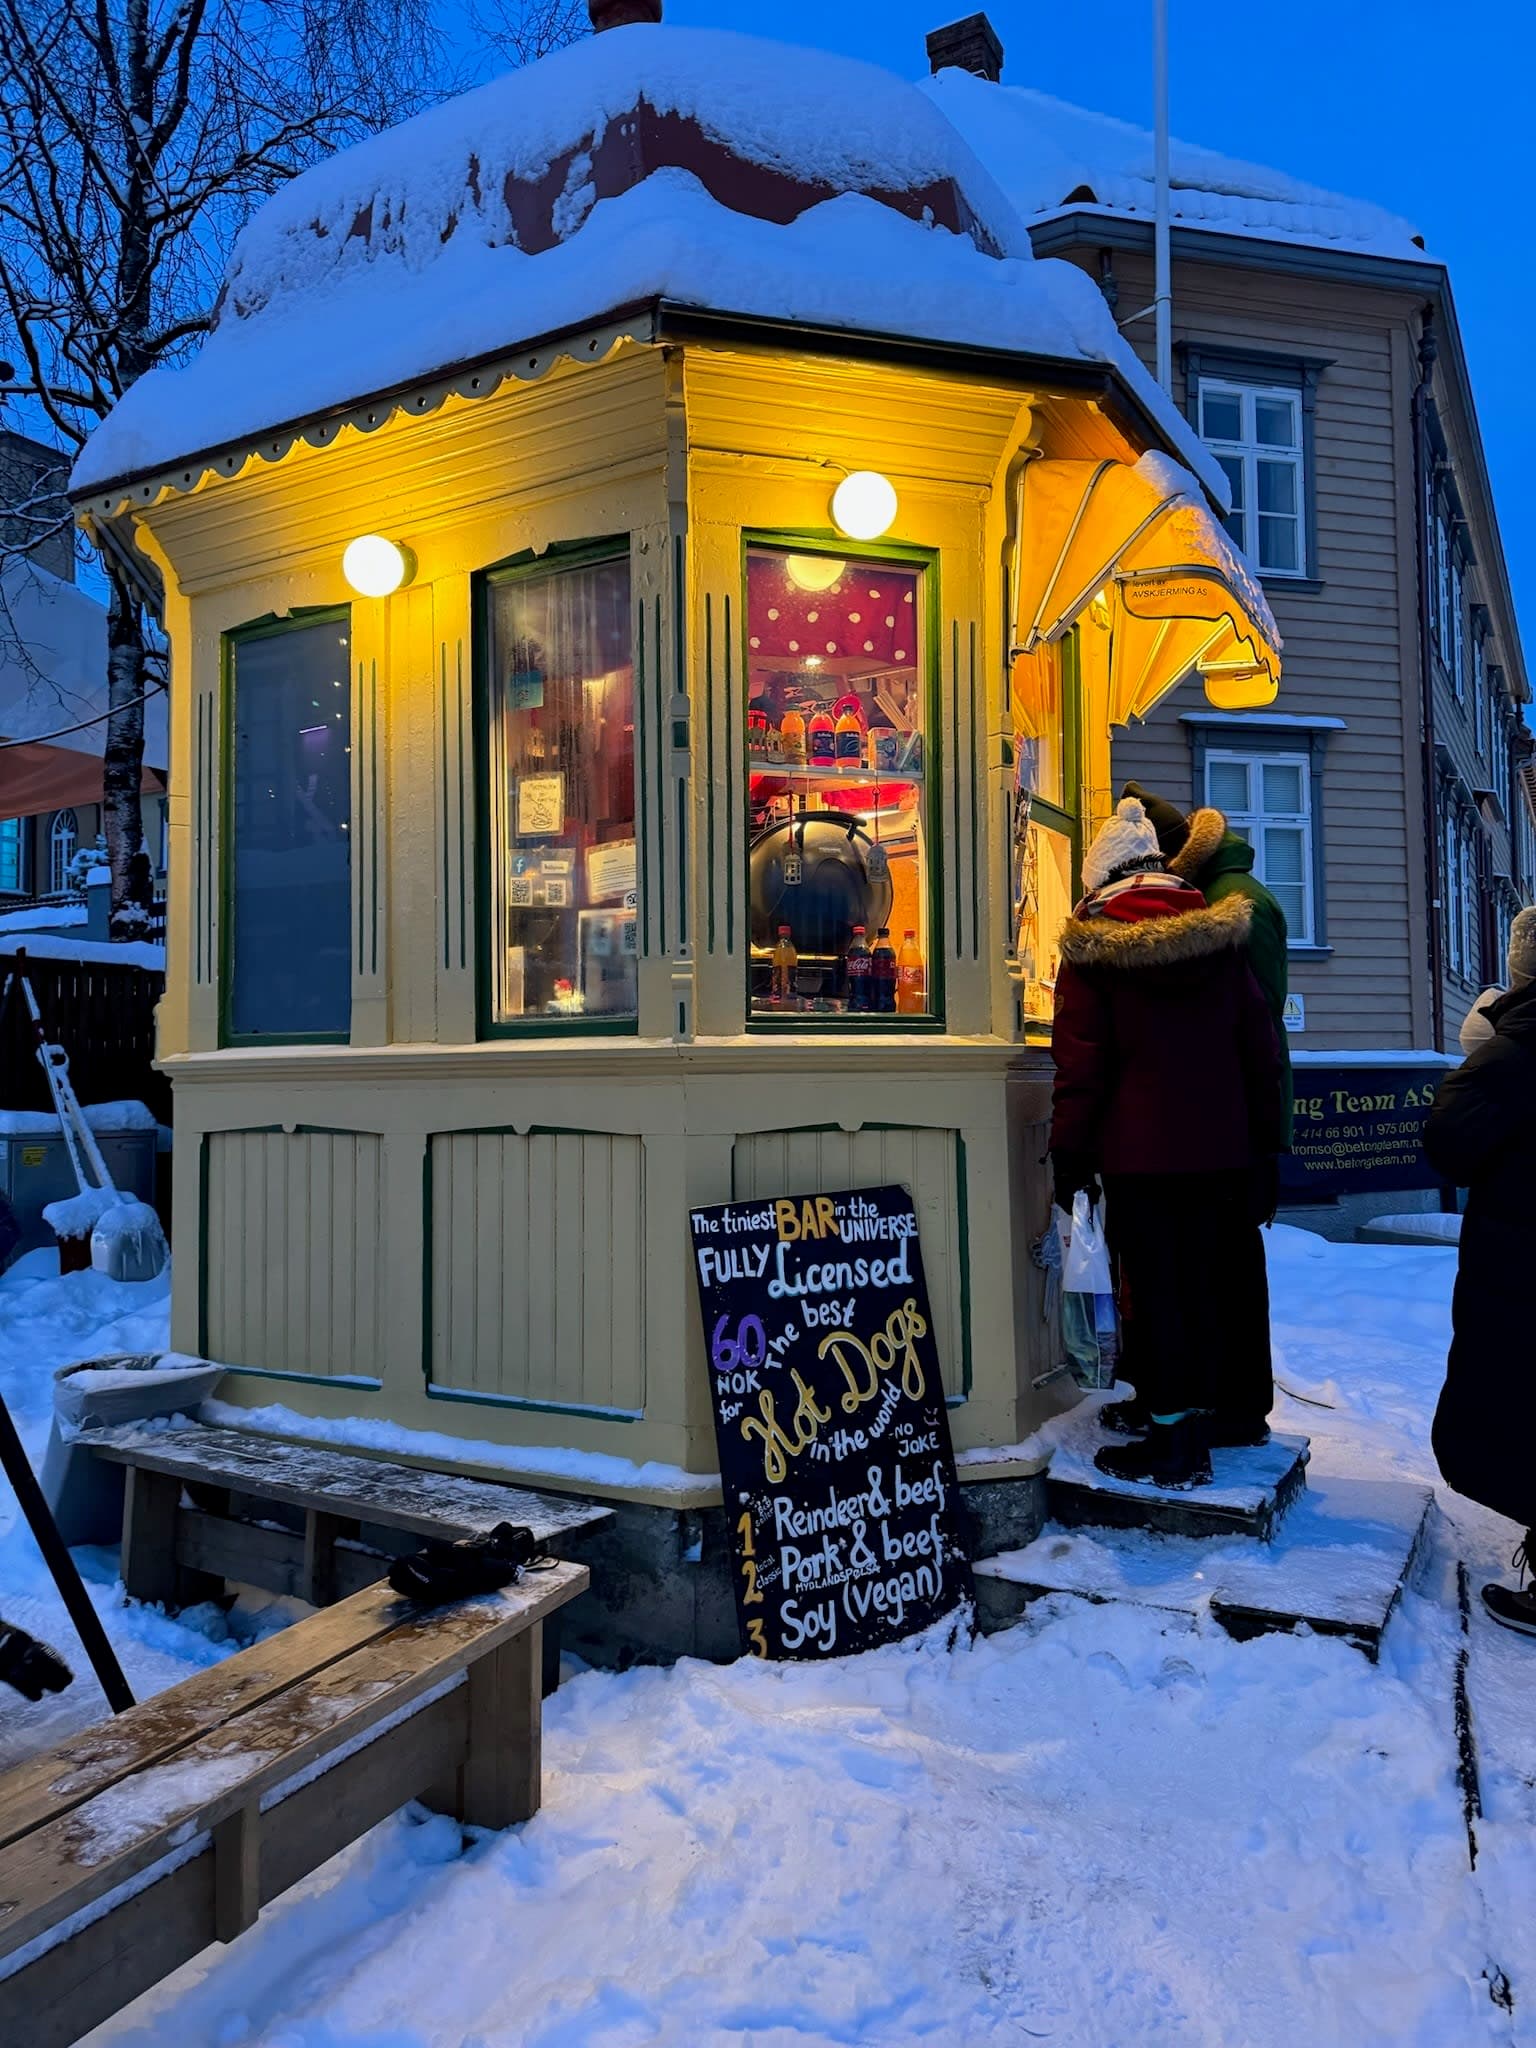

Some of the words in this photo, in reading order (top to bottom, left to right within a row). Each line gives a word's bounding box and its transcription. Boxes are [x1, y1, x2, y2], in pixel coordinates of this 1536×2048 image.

[1132, 587, 1196, 598] AVSKJERMING
[1197, 588, 1208, 596] AS
[1293, 1098, 1324, 1121] ng
[1330, 1090, 1395, 1114] Team
[1403, 1083, 1436, 1109] AS
[1325, 1127, 1340, 1139] 66
[1343, 1126, 1365, 1138] 901
[1377, 1122, 1397, 1136] 975
[1399, 1121, 1419, 1134] 000
[1304, 1154, 1417, 1170] www.betongteam.no
[692, 1213, 719, 1234] The
[722, 1203, 777, 1234] tiniest
[776, 1197, 841, 1241] BAR
[835, 1201, 846, 1217] in
[849, 1197, 879, 1218] the
[839, 1213, 919, 1243] UNIVERSE
[698, 1243, 770, 1287] FULLY
[768, 1236, 914, 1299] Licensed
[712, 1313, 766, 1371] 60
[765, 1323, 800, 1369] The
[801, 1298, 856, 1328] best
[717, 1370, 762, 1395] NOK
[741, 1368, 832, 1483] Hot
[818, 1298, 927, 1413] Dogs
[719, 1400, 743, 1424] for
[810, 1437, 830, 1462] in
[832, 1429, 869, 1461] the
[869, 1378, 901, 1438] world
[898, 1431, 940, 1457] JOKE
[737, 1512, 755, 1556] 1
[774, 1486, 869, 1541] Reindeer
[867, 1465, 891, 1517] &
[896, 1460, 945, 1512] beef
[741, 1560, 763, 1605] 2
[780, 1534, 844, 1590] Pork
[850, 1519, 878, 1569] &
[881, 1513, 945, 1566] beef
[747, 1618, 768, 1658] 3
[780, 1599, 836, 1650] Soy
